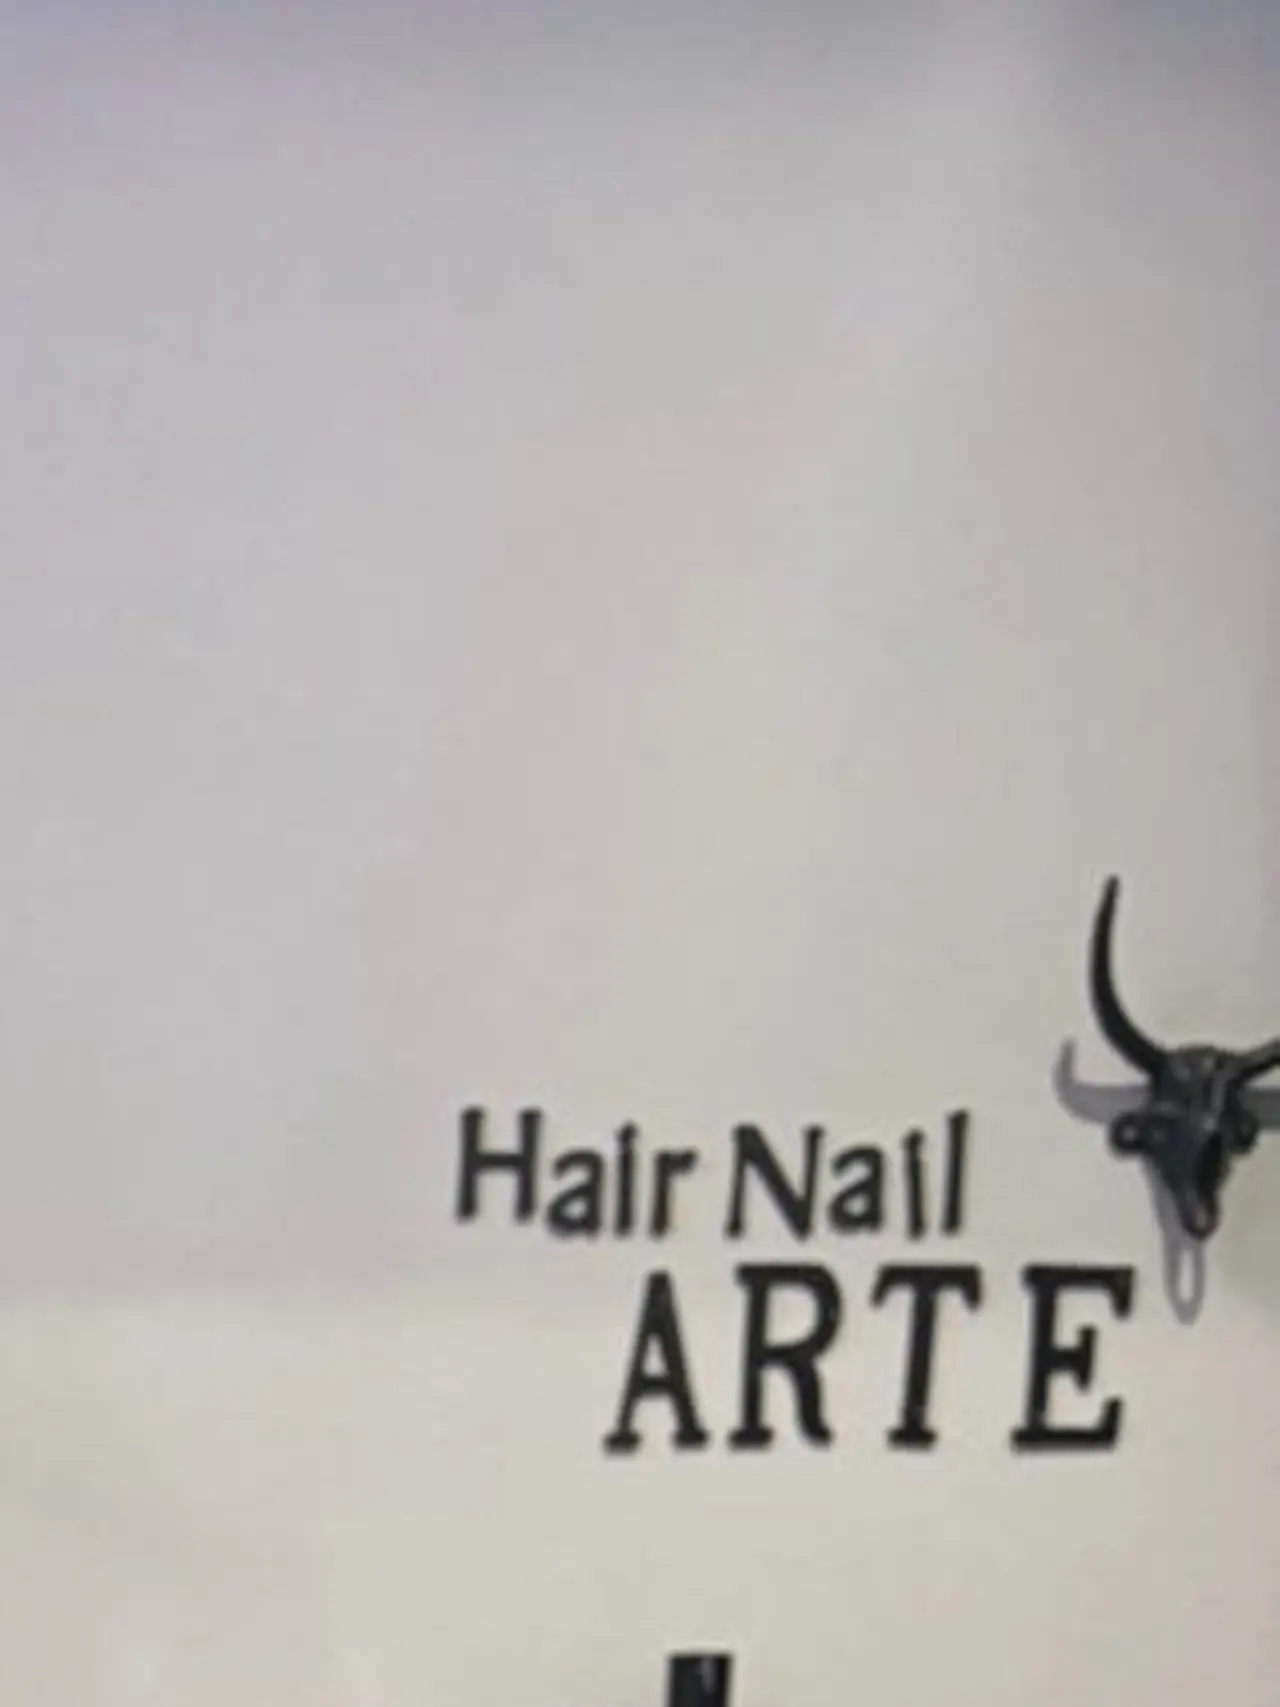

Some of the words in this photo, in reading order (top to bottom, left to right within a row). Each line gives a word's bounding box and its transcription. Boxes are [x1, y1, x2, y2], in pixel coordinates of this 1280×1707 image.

[455, 1107, 698, 1239] Hair
[725, 1110, 971, 1241] Nail
[604, 1262, 1137, 1453] ARTE
